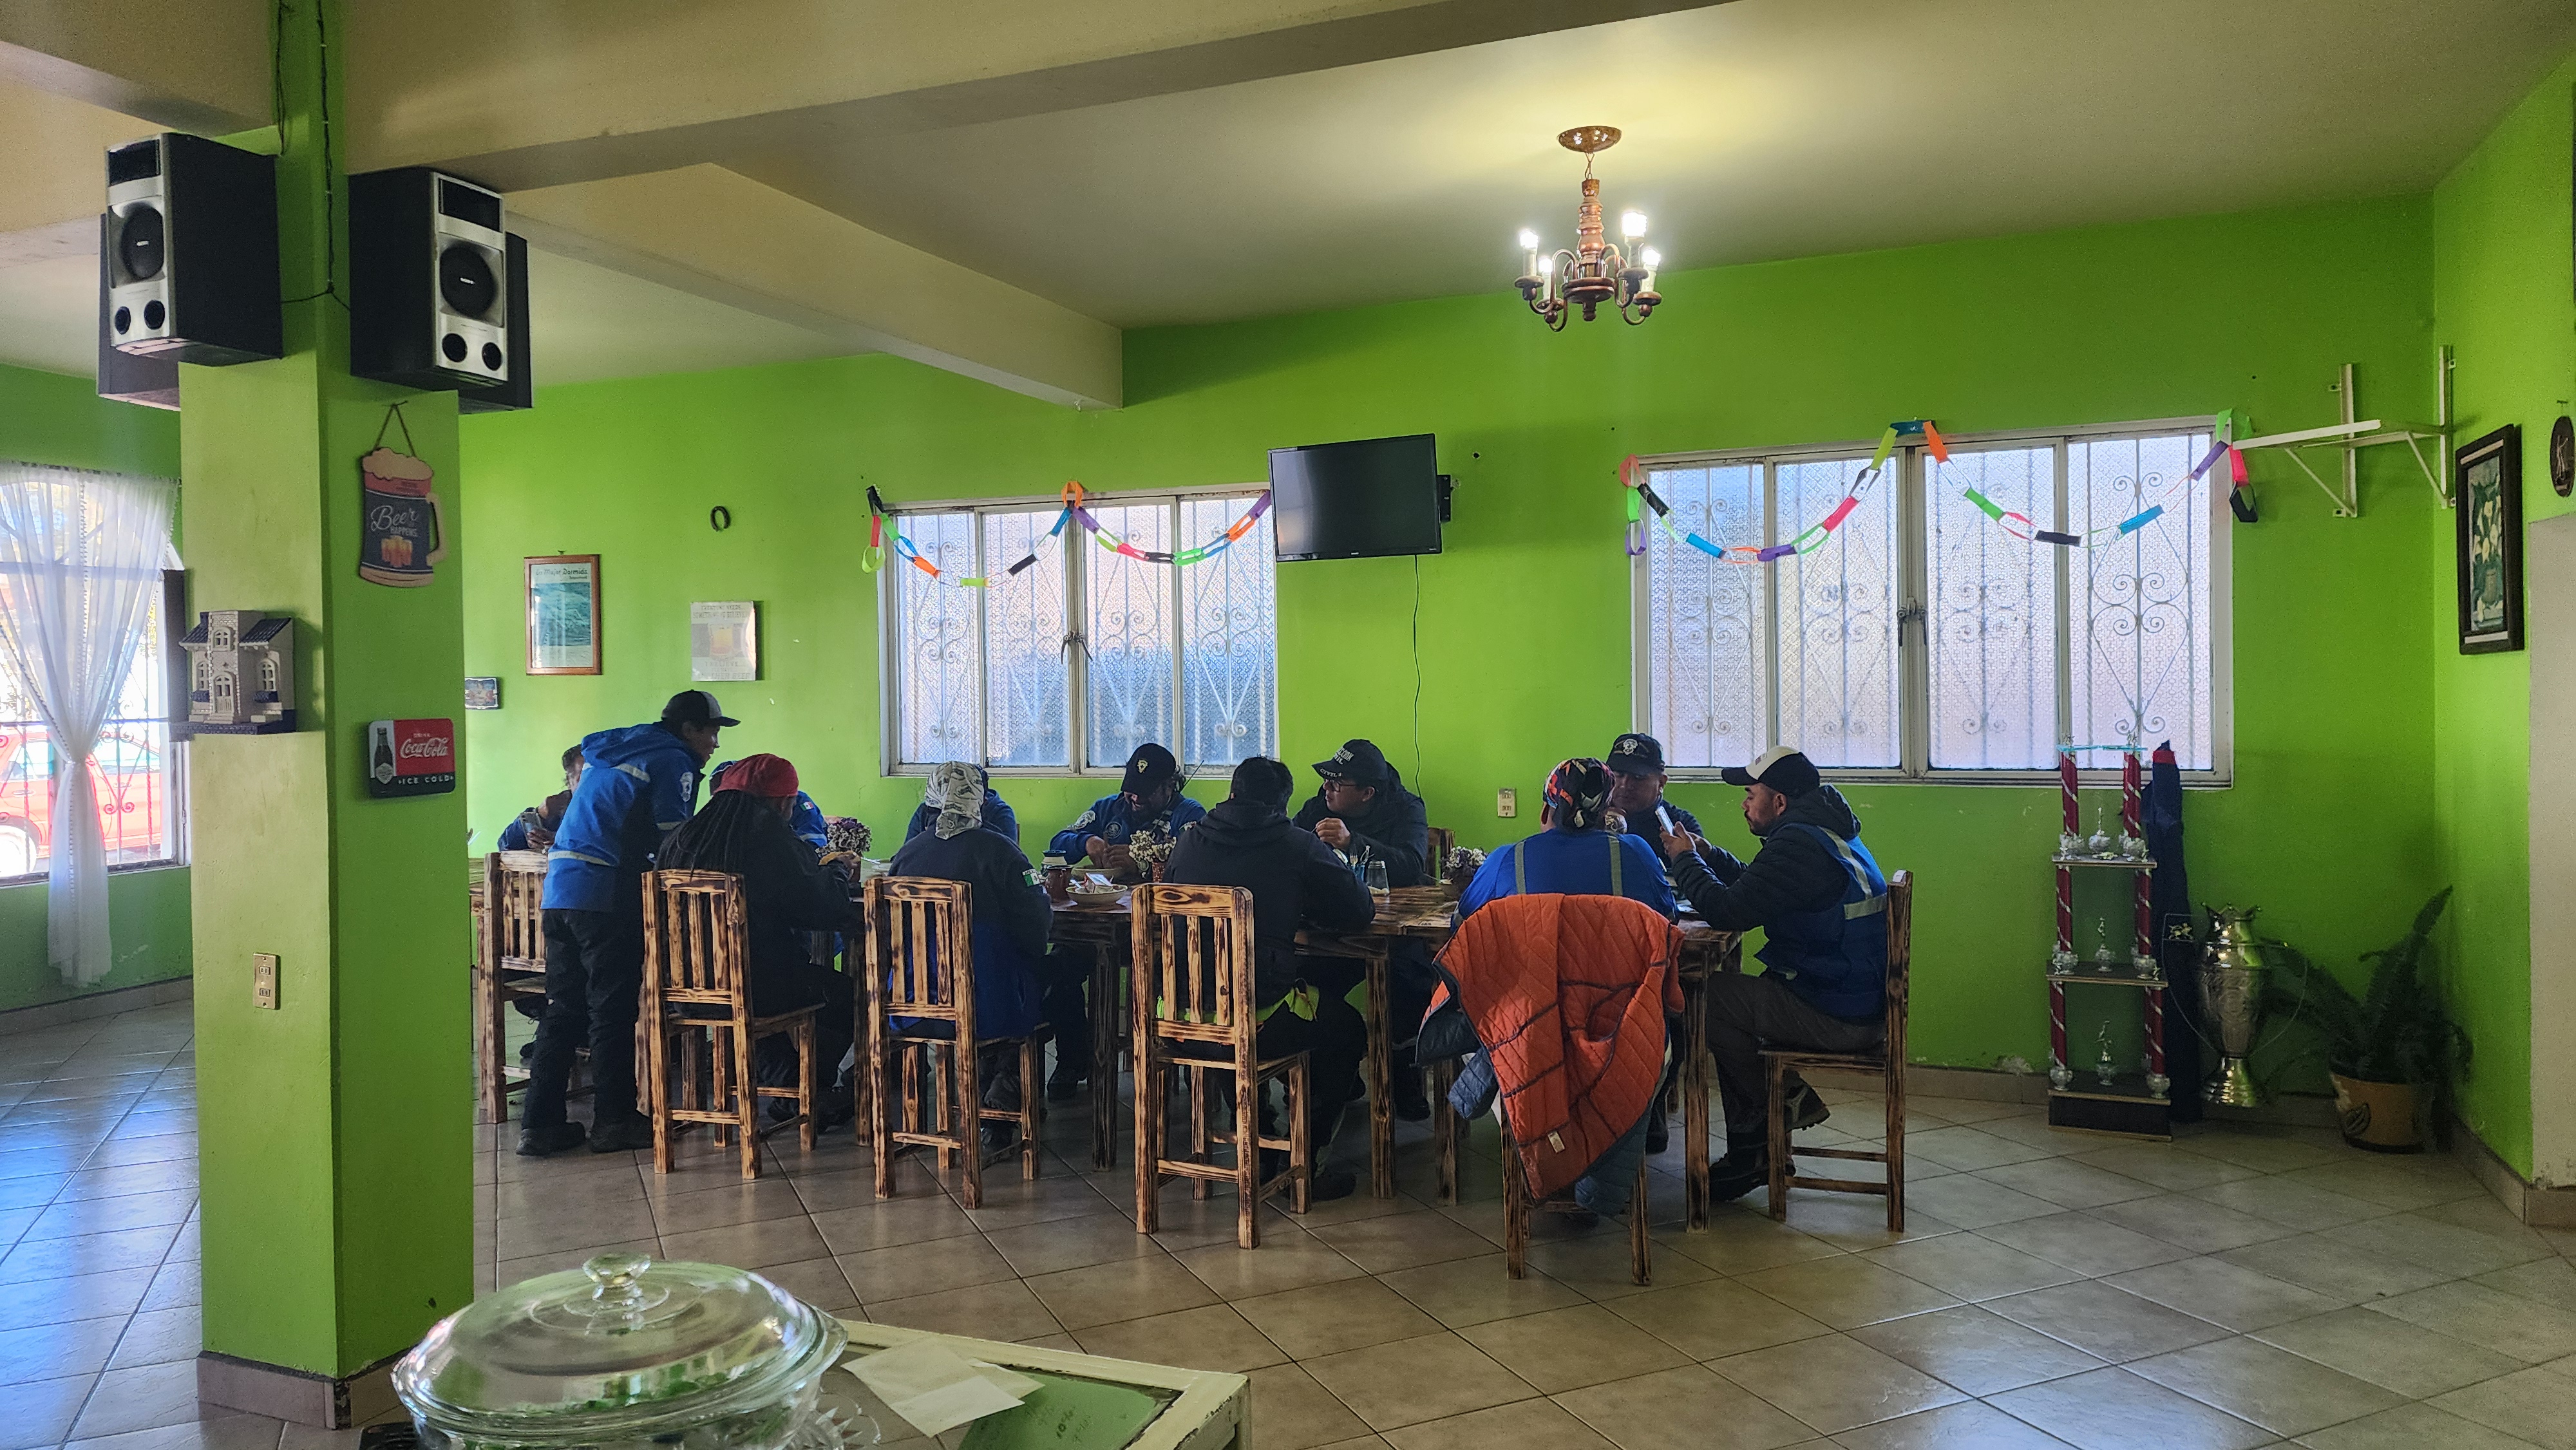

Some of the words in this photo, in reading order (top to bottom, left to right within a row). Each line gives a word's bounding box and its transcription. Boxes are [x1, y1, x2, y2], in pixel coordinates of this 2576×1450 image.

[371, 505, 419, 531] Beer
[399, 737, 449, 759] Coca-Cola
[424, 775, 450, 783] COLD
